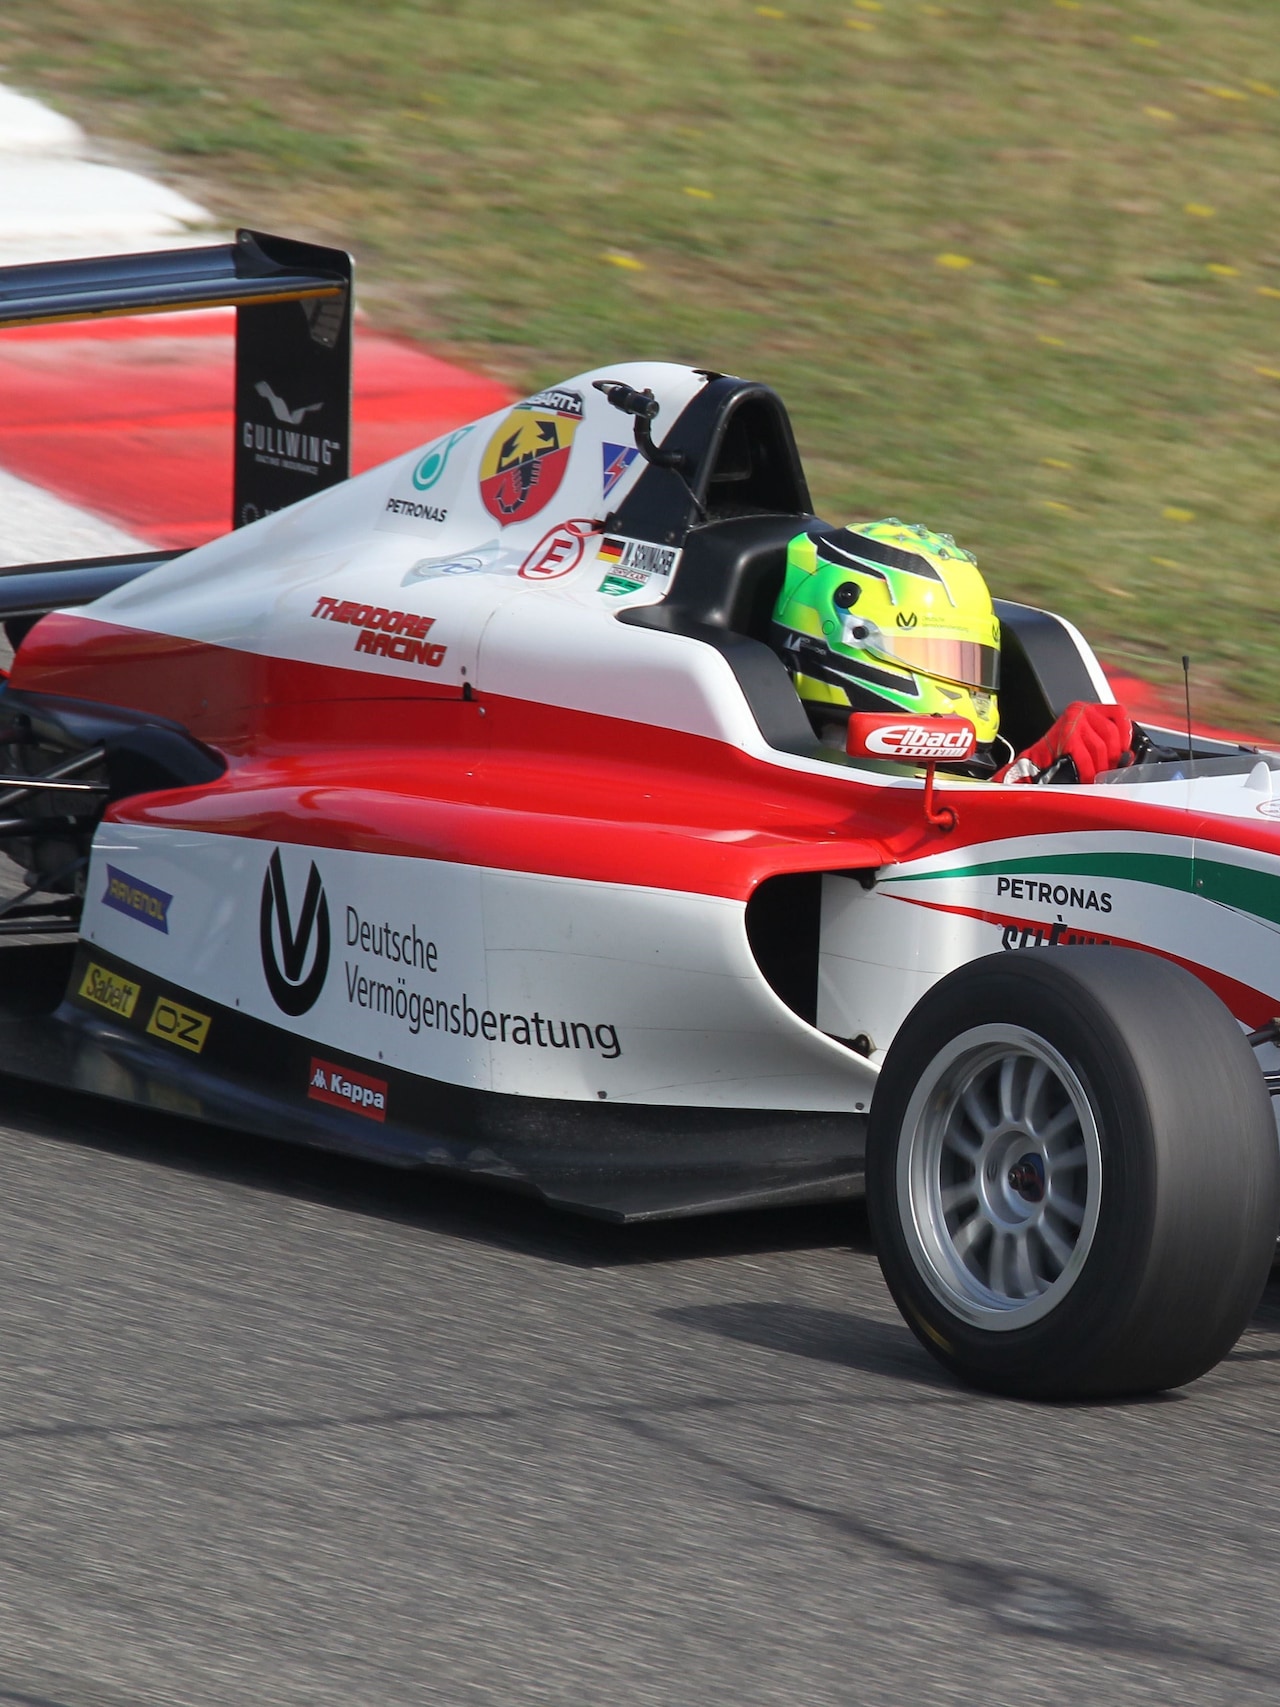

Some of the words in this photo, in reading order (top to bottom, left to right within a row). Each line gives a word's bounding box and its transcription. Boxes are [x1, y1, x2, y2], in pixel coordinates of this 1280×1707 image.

[243, 421, 332, 466] GULLWING
[386, 498, 448, 523] PETRONAS
[530, 538, 573, 575] E
[311, 596, 438, 640] THEODORE
[354, 629, 448, 668] RACING
[865, 724, 974, 757] Eibach
[110, 878, 165, 922] RAVENOL
[997, 876, 1113, 914] PETRONAS
[345, 904, 438, 973] Deutsche
[86, 968, 133, 1014] Sabelt
[344, 960, 622, 1059] Vermögensberatung
[329, 1073, 386, 1110] Kappa
